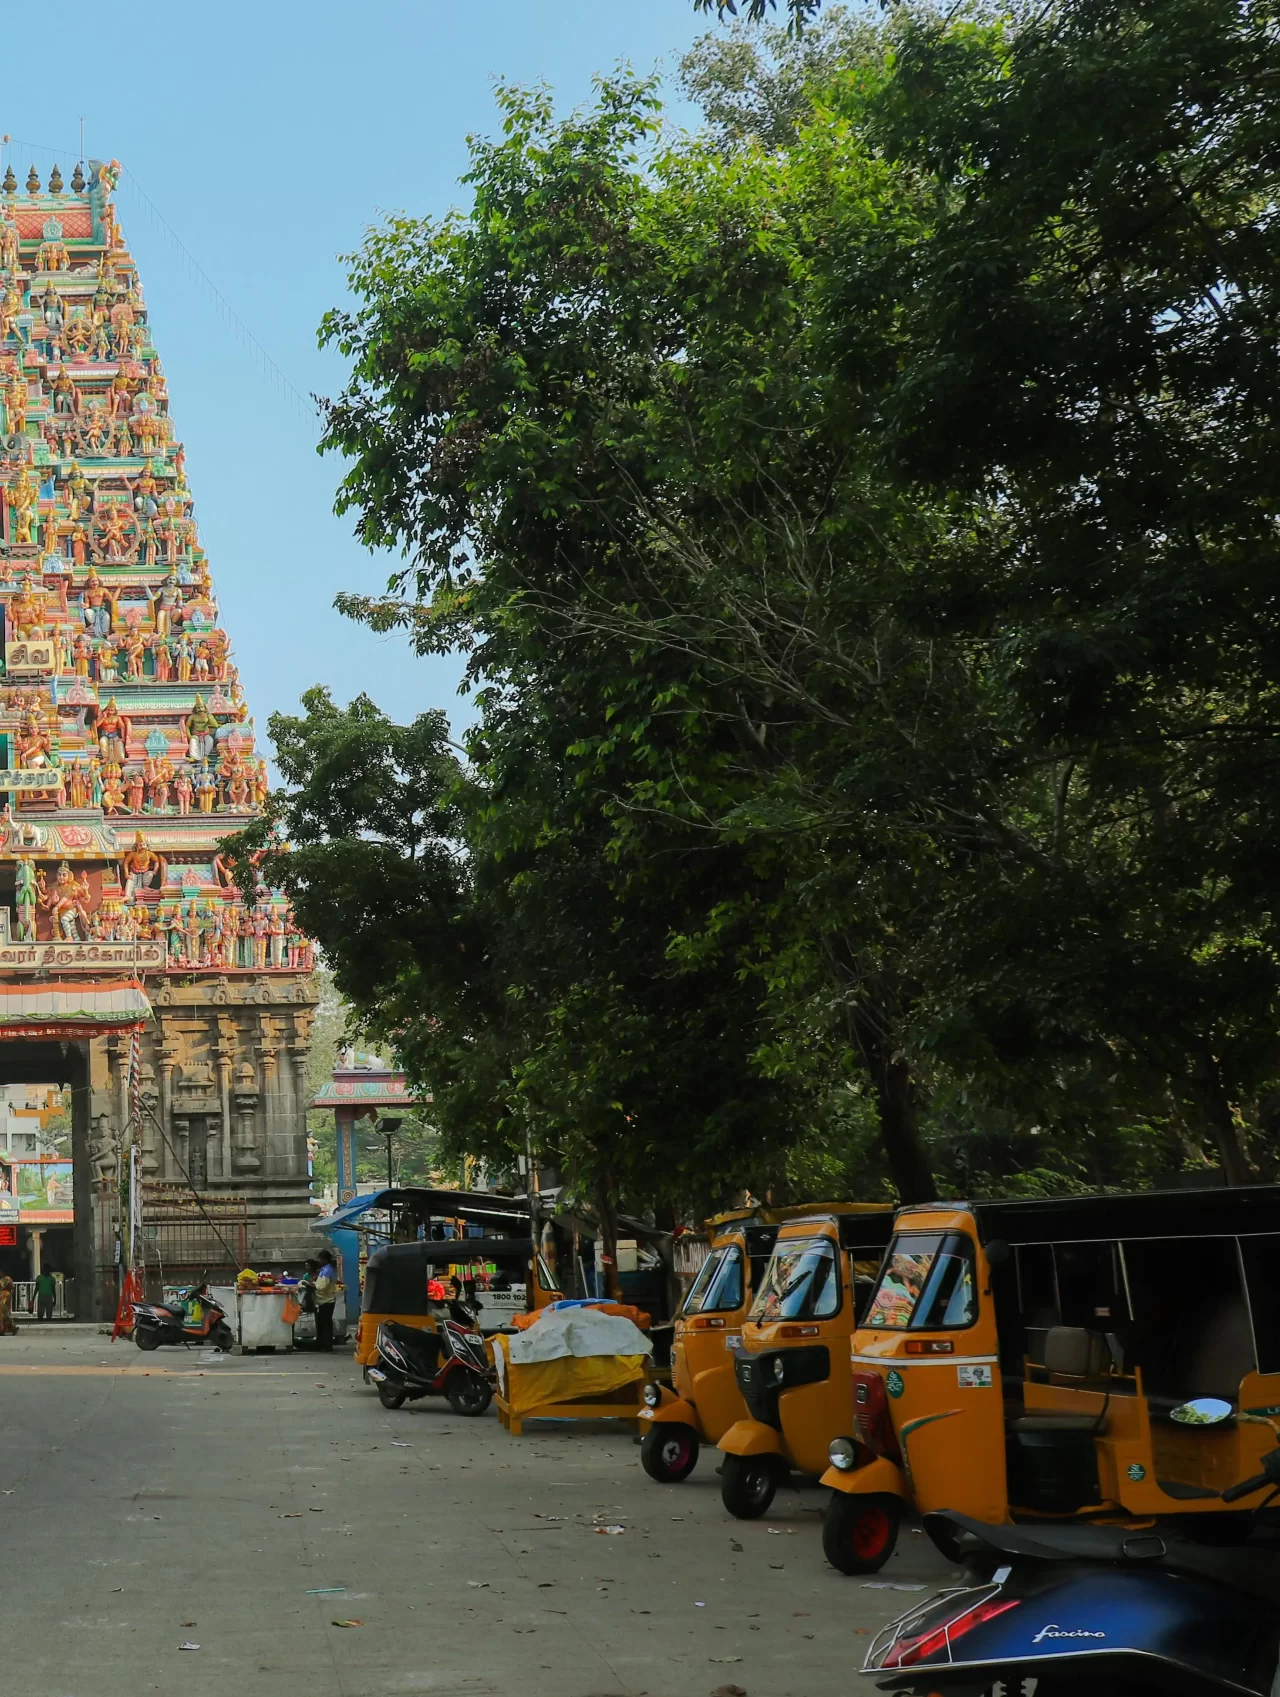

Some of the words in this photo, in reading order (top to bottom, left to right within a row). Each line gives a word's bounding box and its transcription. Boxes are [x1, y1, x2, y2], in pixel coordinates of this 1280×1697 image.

[10, 644, 50, 665] சிவ
[42, 945, 160, 967] திருக்கோயில்
[1032, 1624, 1106, 1643] fascino
